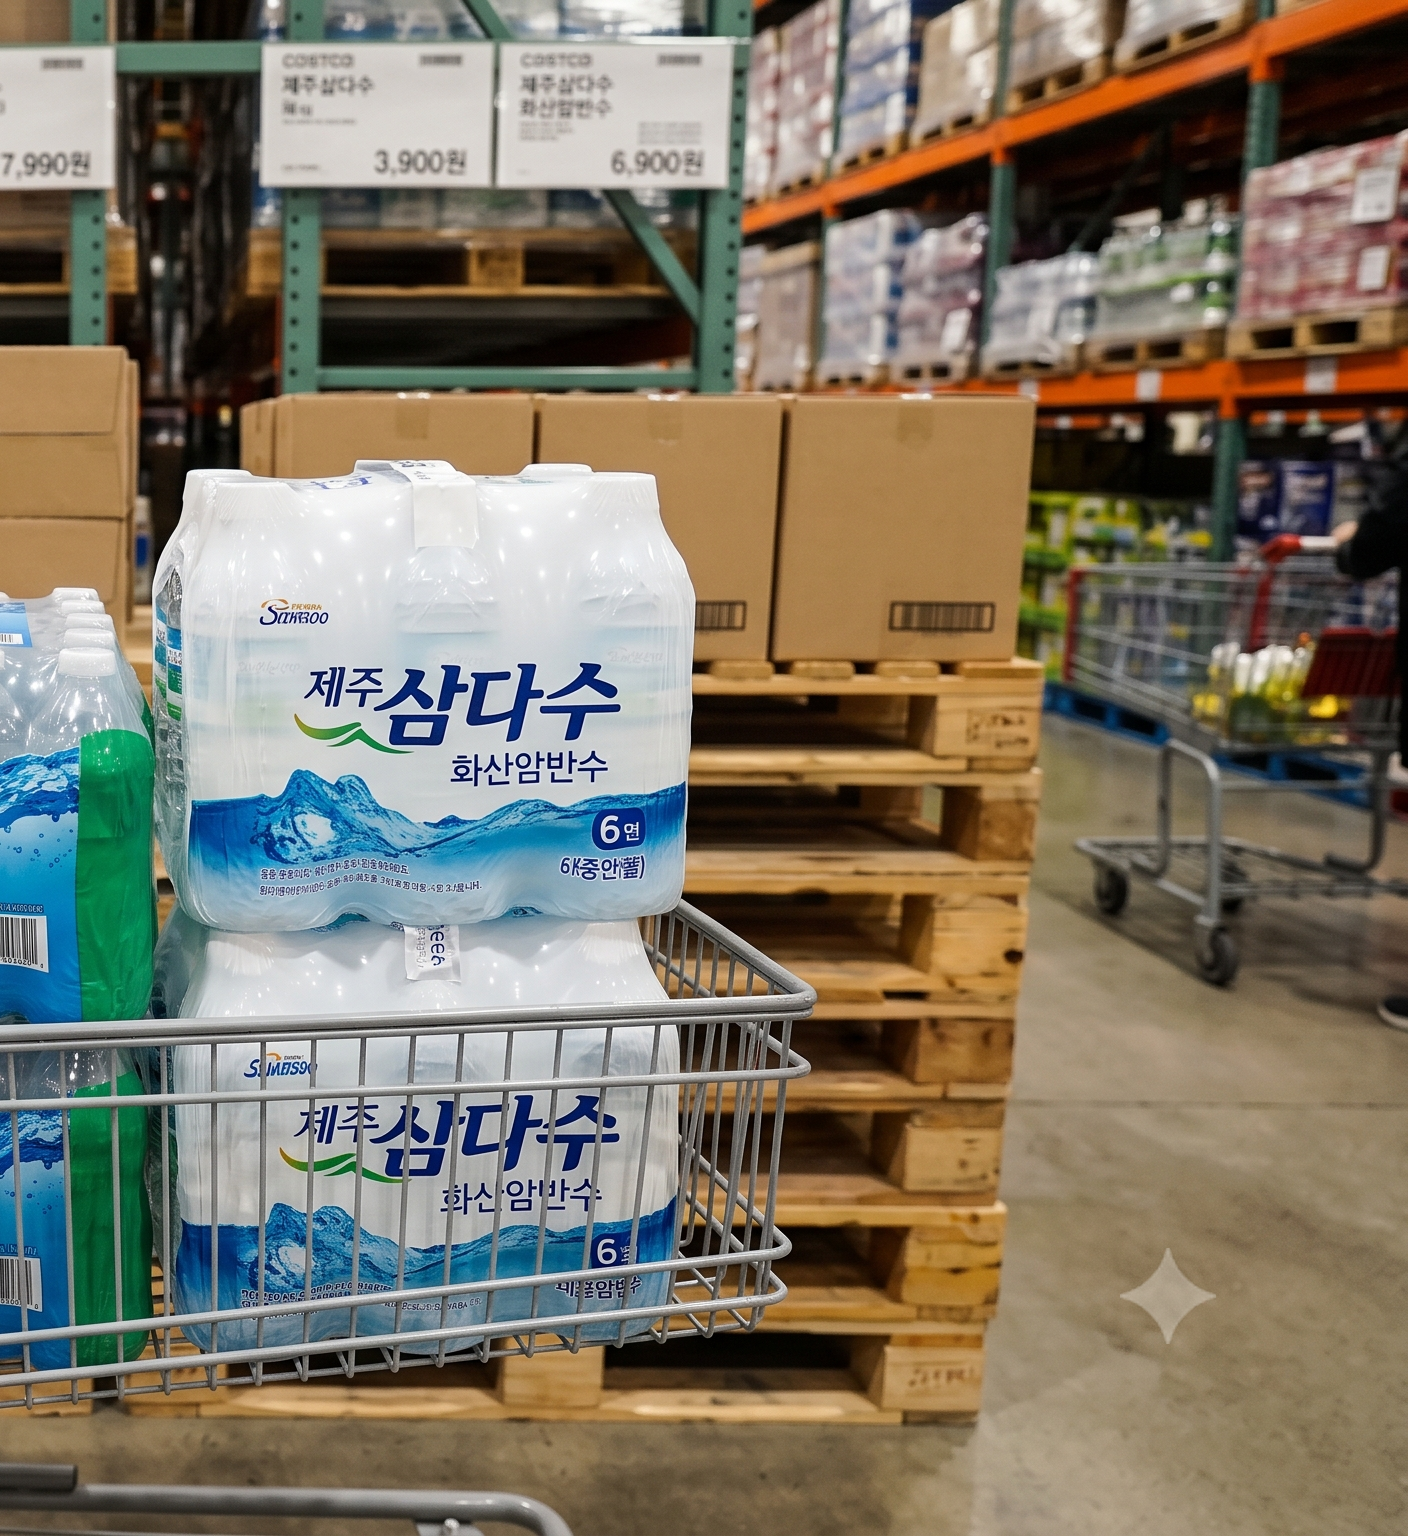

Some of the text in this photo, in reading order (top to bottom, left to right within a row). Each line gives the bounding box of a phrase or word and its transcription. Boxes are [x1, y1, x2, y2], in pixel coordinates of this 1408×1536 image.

[282, 54, 355, 68] COSTCO
[520, 53, 593, 68] COSTCO
[282, 75, 373, 96] 제주삼다수
[520, 75, 613, 95] 제주삼다수
[0, 151, 90, 179] 7,990원
[374, 149, 466, 178] 3,900원
[611, 150, 704, 178] 6,900원
[304, 662, 622, 748] 제주 삼다수
[450, 750, 609, 787] 화산암반수
[600, 815, 620, 844] 6
[294, 1094, 620, 1177] 제주 삼다수
[597, 1238, 617, 1265] 6
